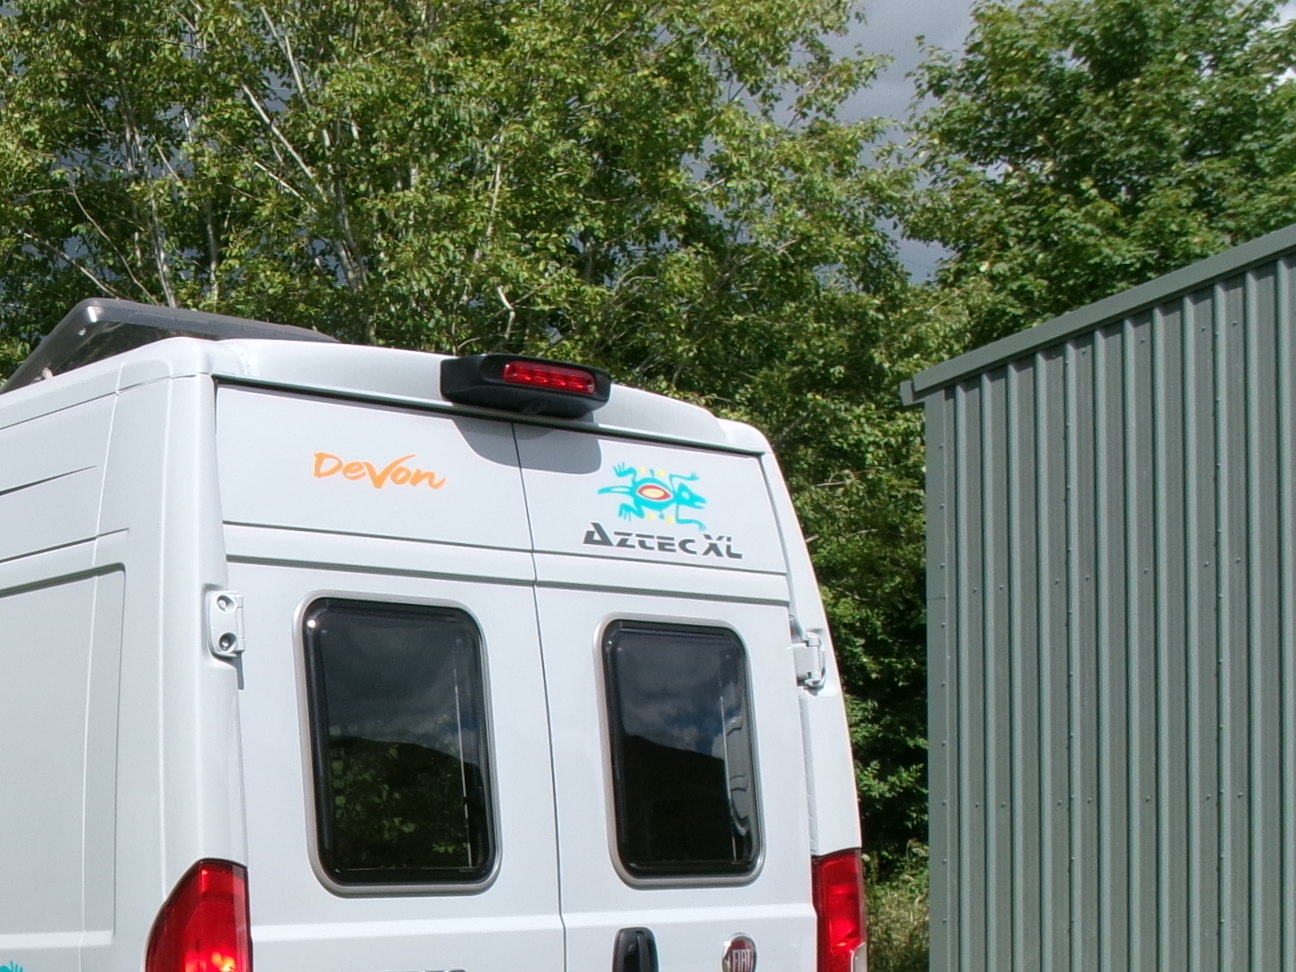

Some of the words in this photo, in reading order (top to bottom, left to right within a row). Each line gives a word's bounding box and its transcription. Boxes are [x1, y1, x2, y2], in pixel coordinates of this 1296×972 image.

[582, 521, 698, 556] AZTEC
[702, 533, 743, 560] XL
[732, 948, 751, 972] FIAT
